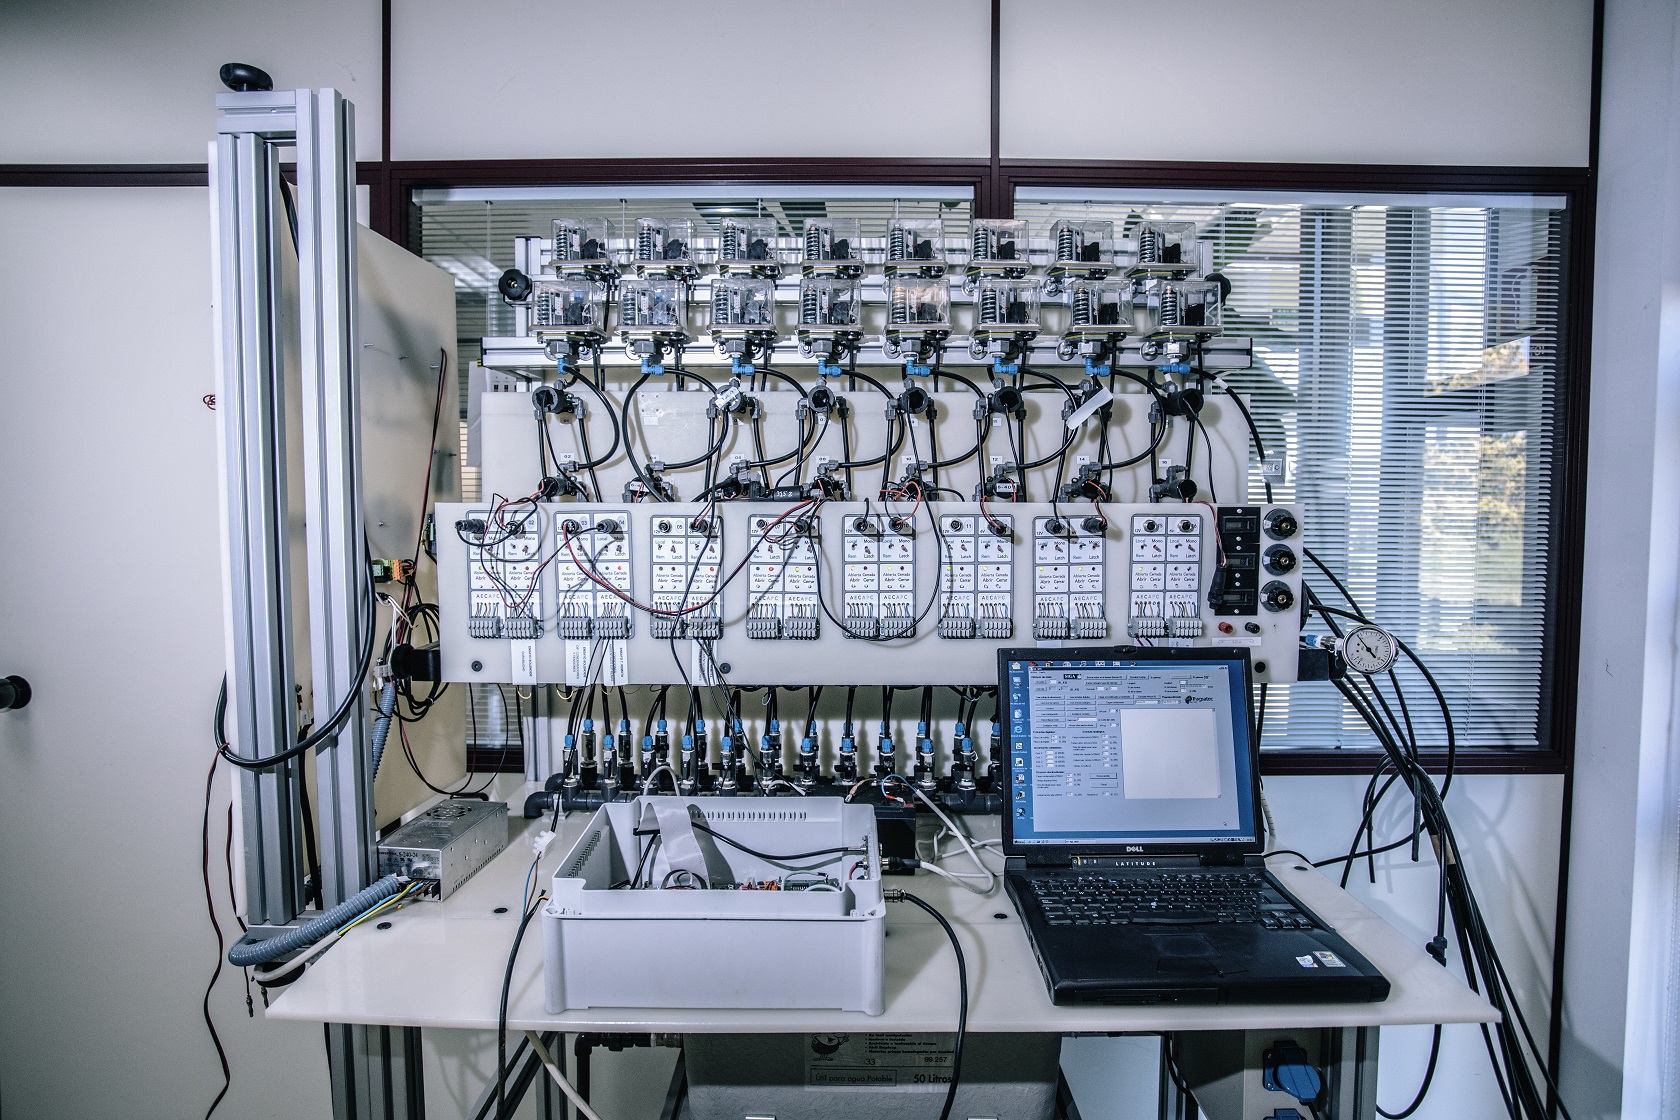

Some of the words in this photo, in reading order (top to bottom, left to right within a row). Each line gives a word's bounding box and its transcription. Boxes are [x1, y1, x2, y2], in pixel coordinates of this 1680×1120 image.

[829, 1075, 846, 1083] para
[848, 1075, 865, 1084] agua
[867, 1074, 893, 1082] Potable
[913, 1074, 925, 1083] 50
[929, 1074, 953, 1083] Litros
